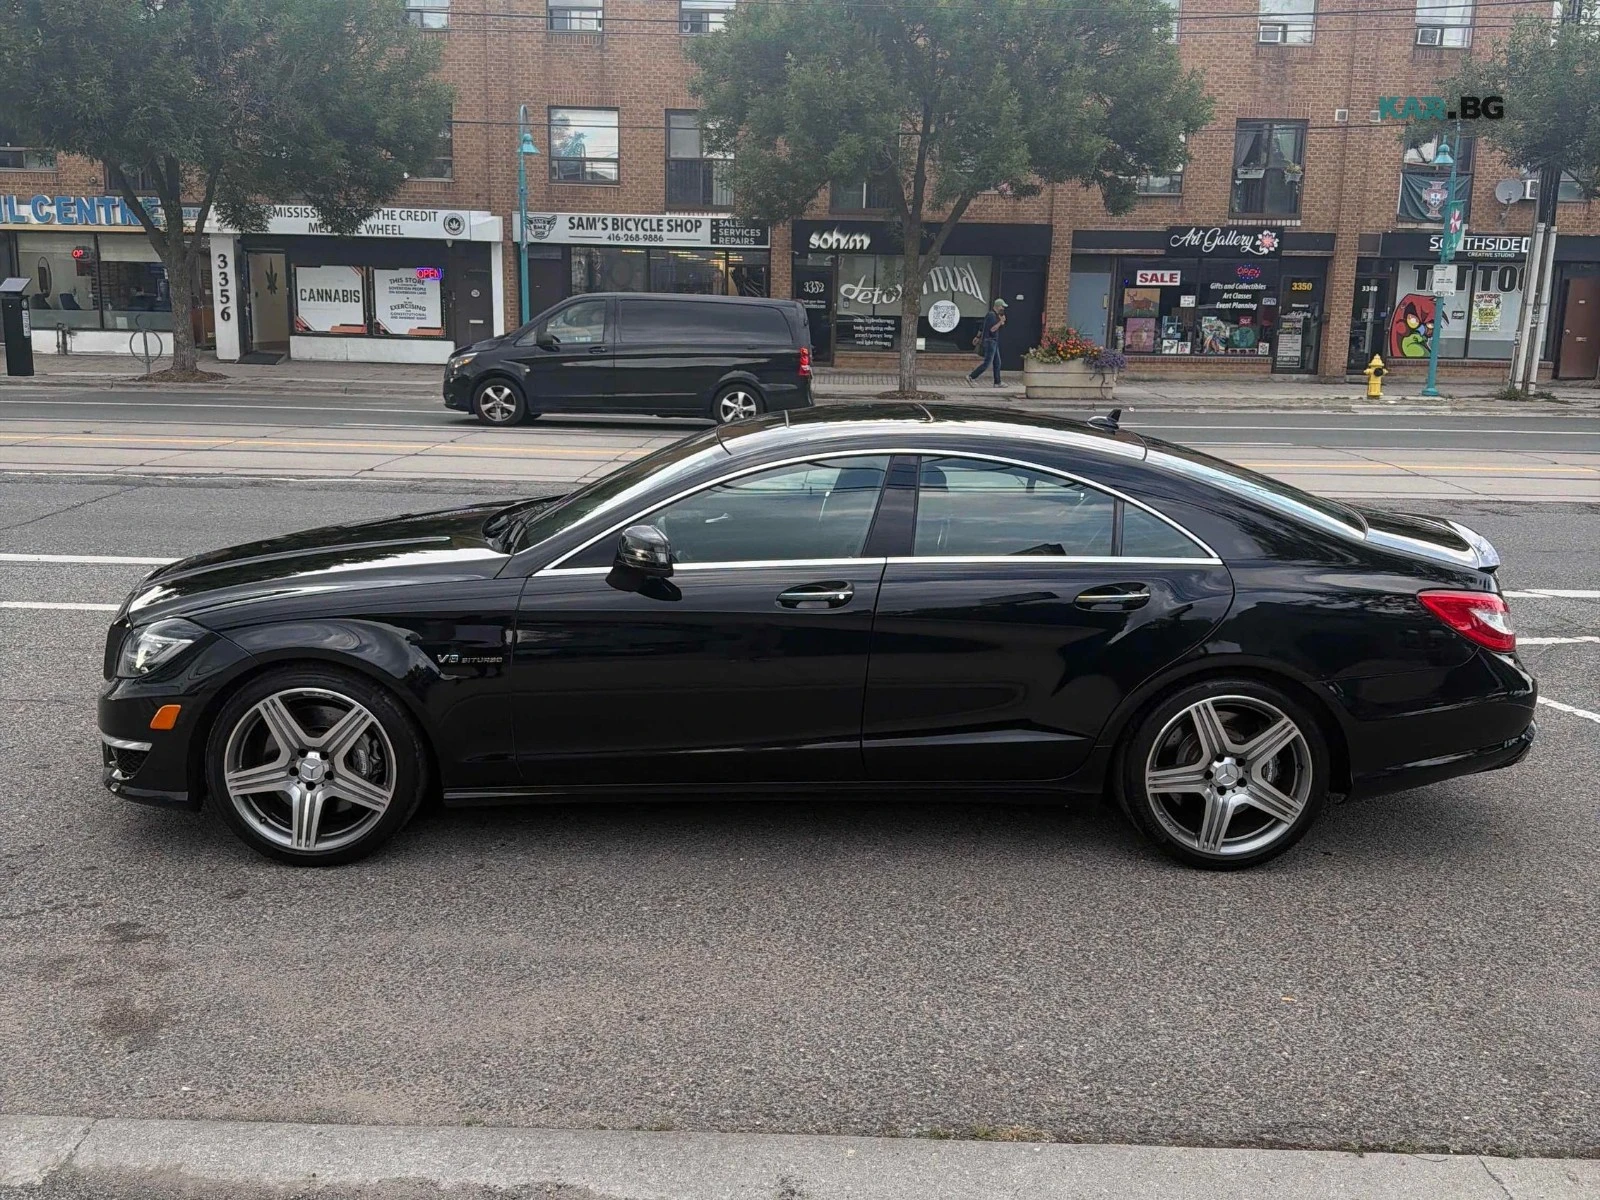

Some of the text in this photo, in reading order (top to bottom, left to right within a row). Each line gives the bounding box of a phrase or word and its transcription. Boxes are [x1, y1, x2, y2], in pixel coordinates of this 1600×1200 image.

[399, 210, 438, 222] CREDIT
[364, 223, 404, 235] WHEEL
[568, 216, 703, 233] SAM'S BICYCLE SHOP
[606, 233, 664, 242] 416-268-9886
[718, 228, 761, 237] SERVICES
[718, 236, 755, 245] REPAIRS
[1169, 227, 1267, 255] Art Gallery
[1429, 236, 1521, 251] STHSIDE
[416, 269, 439, 279] OPEN
[1138, 272, 1179, 284] SALE
[1412, 263, 1526, 292] TTTO
[405, 277, 425, 285] STORE
[1210, 282, 1223, 290] Gifts
[1291, 281, 1313, 291] 3350
[217, 253, 232, 322] 3356
[803, 280, 825, 294] 3352
[300, 288, 361, 303] CANNABIS
[1232, 292, 1253, 300] Classes
[389, 303, 427, 311] EXERCISING
[1216, 301, 1258, 311] Event Planning
[437, 654, 503, 664] V8 BITURBO
